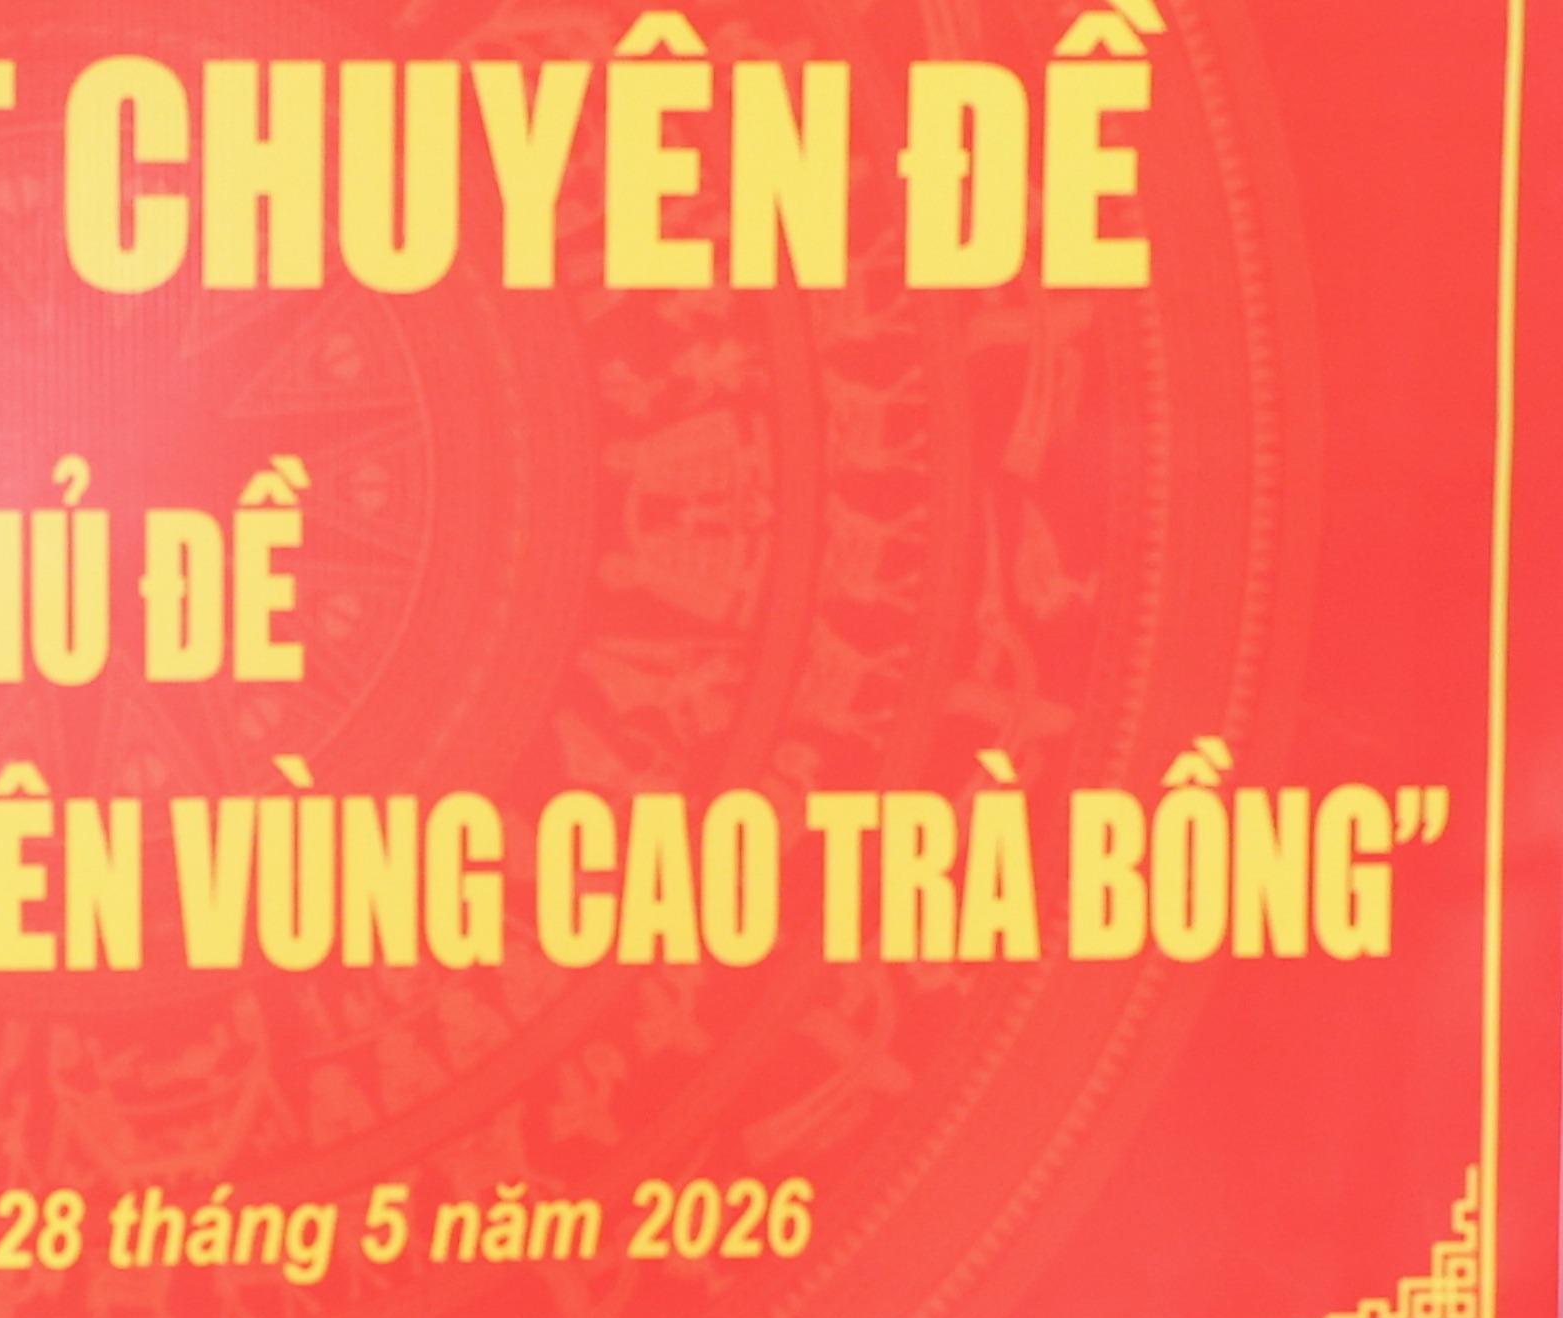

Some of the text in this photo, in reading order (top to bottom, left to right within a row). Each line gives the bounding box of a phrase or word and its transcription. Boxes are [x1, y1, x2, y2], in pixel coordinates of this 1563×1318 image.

[63, 10, 851, 295] CHUYÊN
[896, 0, 1167, 290] ĐỀ
[138, 454, 312, 684] ĐỀ
[169, 754, 505, 972] VÙNG
[536, 789, 780, 968] CAO
[805, 749, 1041, 963] TRÀ
[1068, 735, 1450, 962] BỒNG”
[107, 1184, 338, 1285] tháng
[361, 1183, 410, 1263] 5
[429, 1182, 602, 1263] năm
[628, 1177, 813, 1261] 2026
